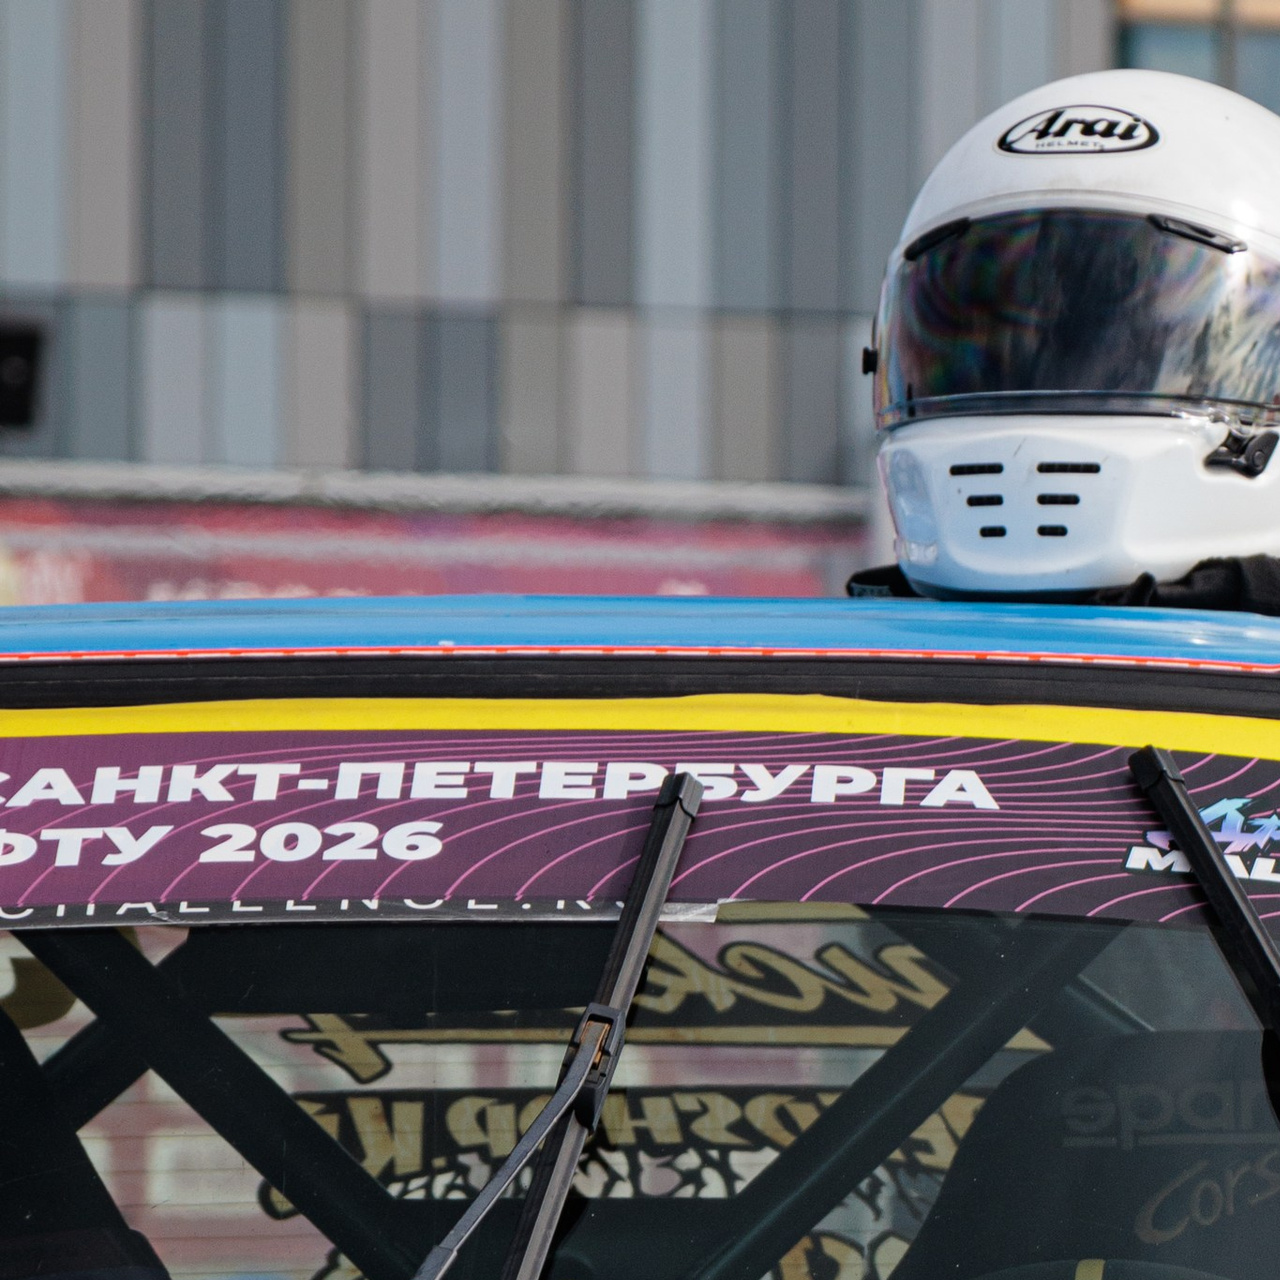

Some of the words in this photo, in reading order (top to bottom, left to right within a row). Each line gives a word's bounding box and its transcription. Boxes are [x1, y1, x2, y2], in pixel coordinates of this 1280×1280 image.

[1006, 109, 1142, 147] Arai
[0, 762, 1000, 809] АНКТ-ПЕТЕРБУРГА
[198, 822, 443, 863] 2026
